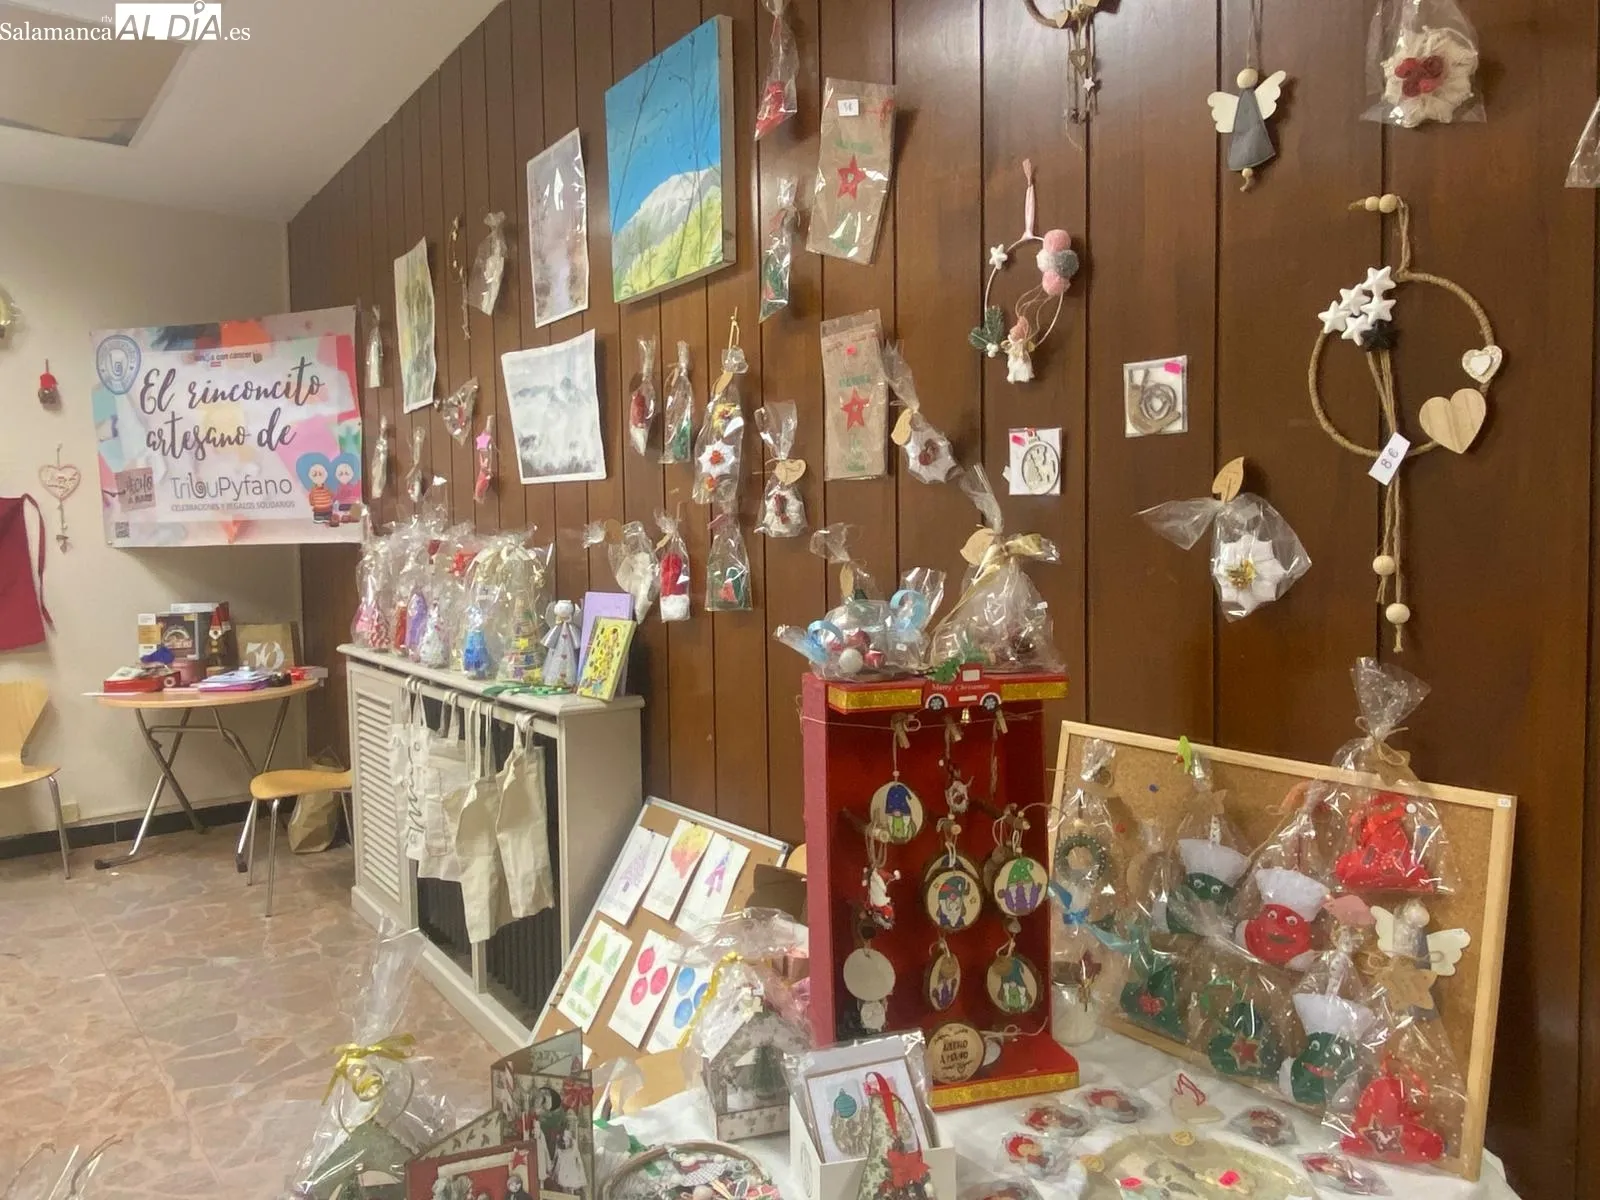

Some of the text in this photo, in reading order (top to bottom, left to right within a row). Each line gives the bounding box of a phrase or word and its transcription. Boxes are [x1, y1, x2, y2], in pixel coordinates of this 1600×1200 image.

[140, 367, 176, 415] El
[188, 356, 325, 409] rinconcito
[146, 407, 297, 461] artesano de
